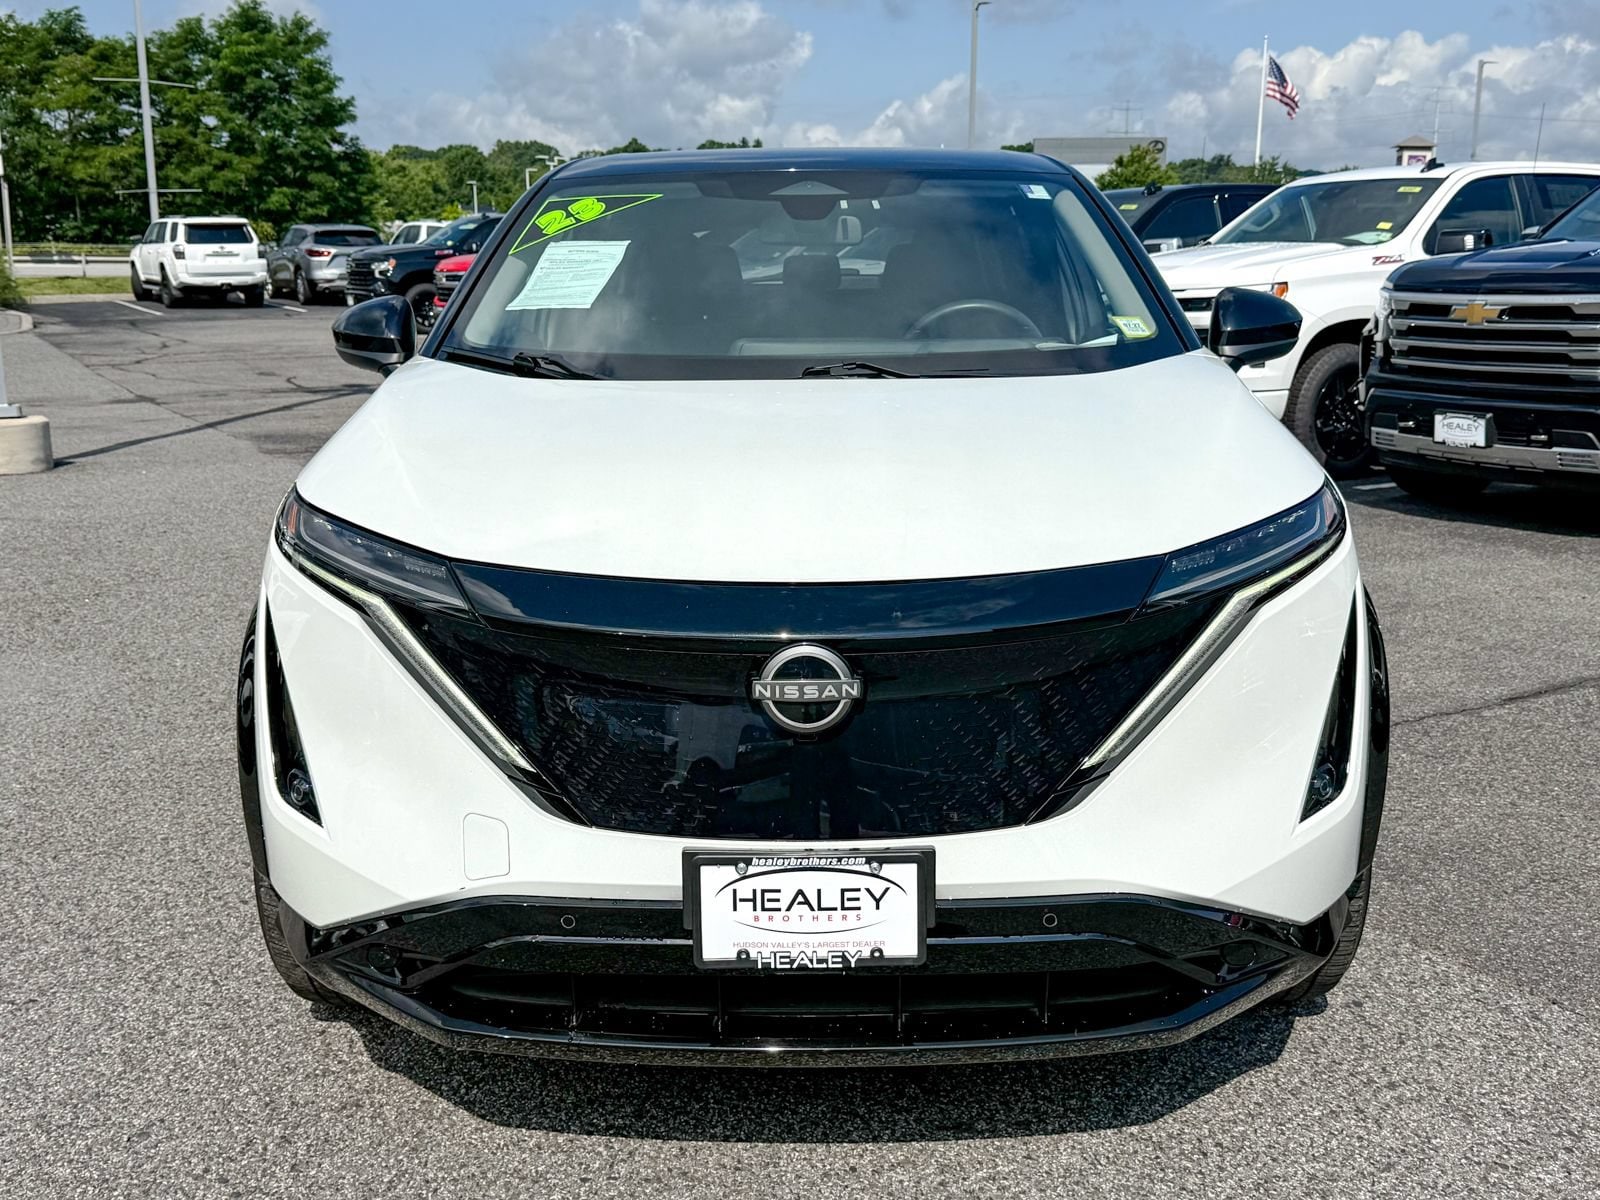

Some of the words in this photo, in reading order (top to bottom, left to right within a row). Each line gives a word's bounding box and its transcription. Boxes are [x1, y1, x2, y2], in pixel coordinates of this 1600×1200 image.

[535, 197, 606, 235] 23
[1442, 421, 1479, 432] HEALEY
[755, 682, 859, 699] NISSAN
[751, 857, 866, 867] healeybrothers.com
[732, 887, 891, 912] HEALEY
[753, 914, 862, 923] BROTHERS
[732, 941, 769, 949] HUDSON
[770, 941, 810, 949] VALLEY'S
[812, 940, 850, 948] LARGEST
[852, 940, 886, 948] DEALER
[756, 950, 862, 969] HEALEY
